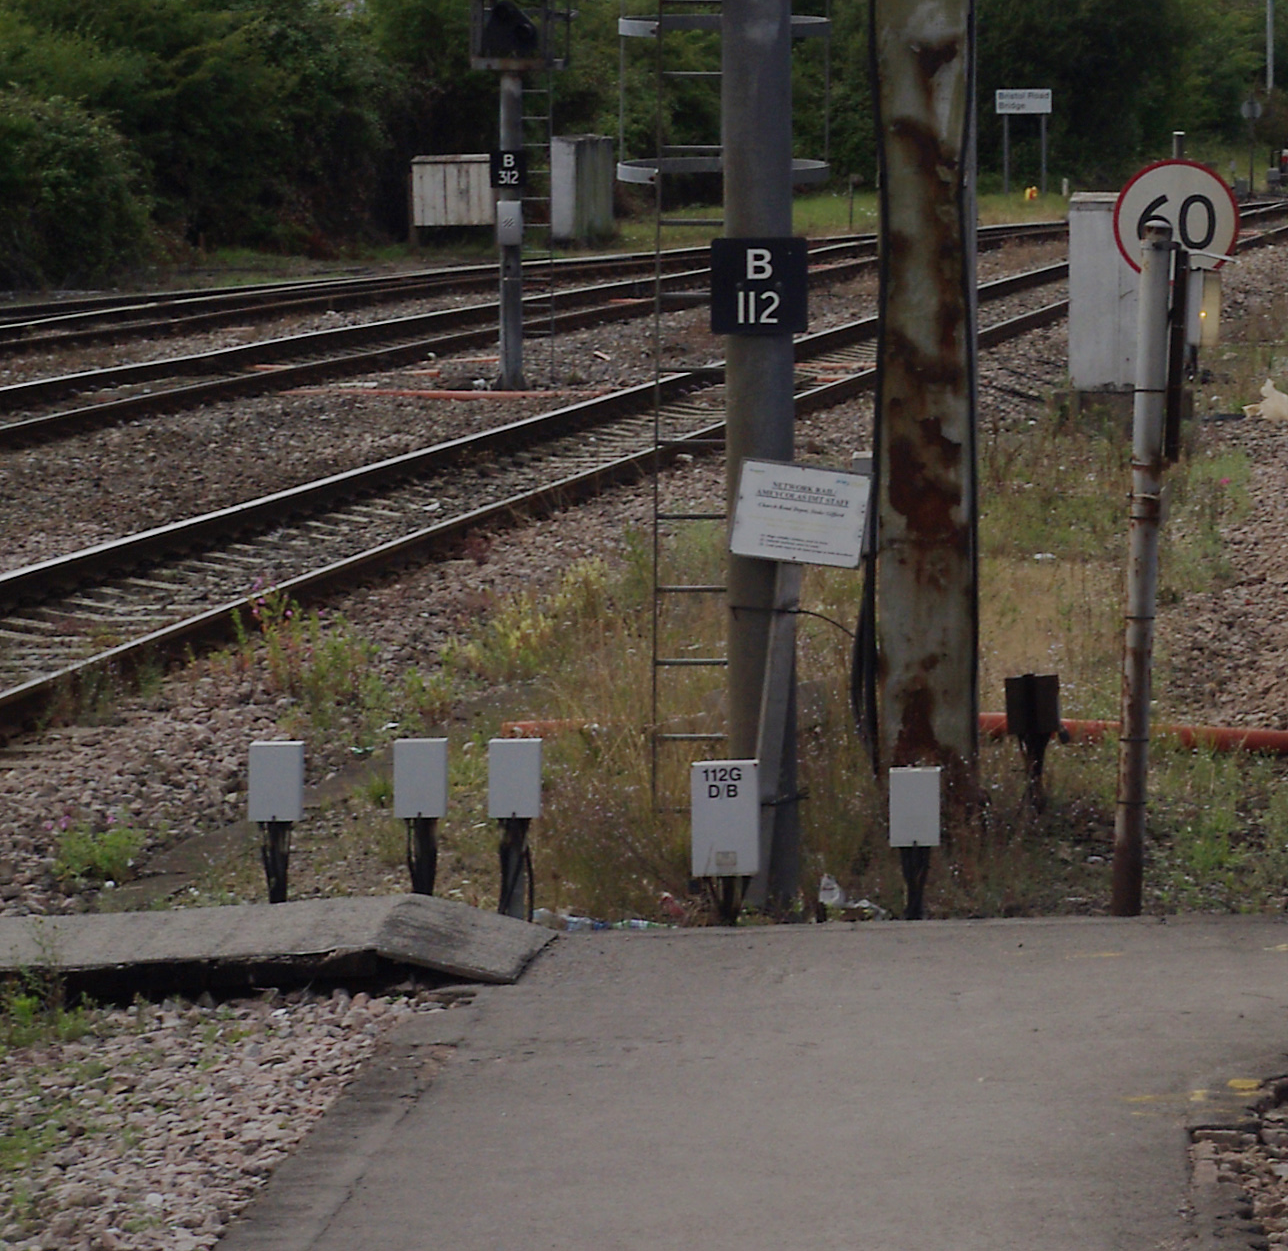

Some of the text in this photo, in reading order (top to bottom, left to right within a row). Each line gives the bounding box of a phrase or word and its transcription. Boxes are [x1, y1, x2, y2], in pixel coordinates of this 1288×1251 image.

[1027, 91, 1050, 99] Road
[998, 101, 1026, 111] Bridge
[503, 154, 515, 168] B
[498, 170, 519, 185] 312
[1137, 194, 1216, 250] 60
[746, 248, 773, 281] B
[737, 291, 779, 325] 112
[702, 767, 742, 782] 112G
